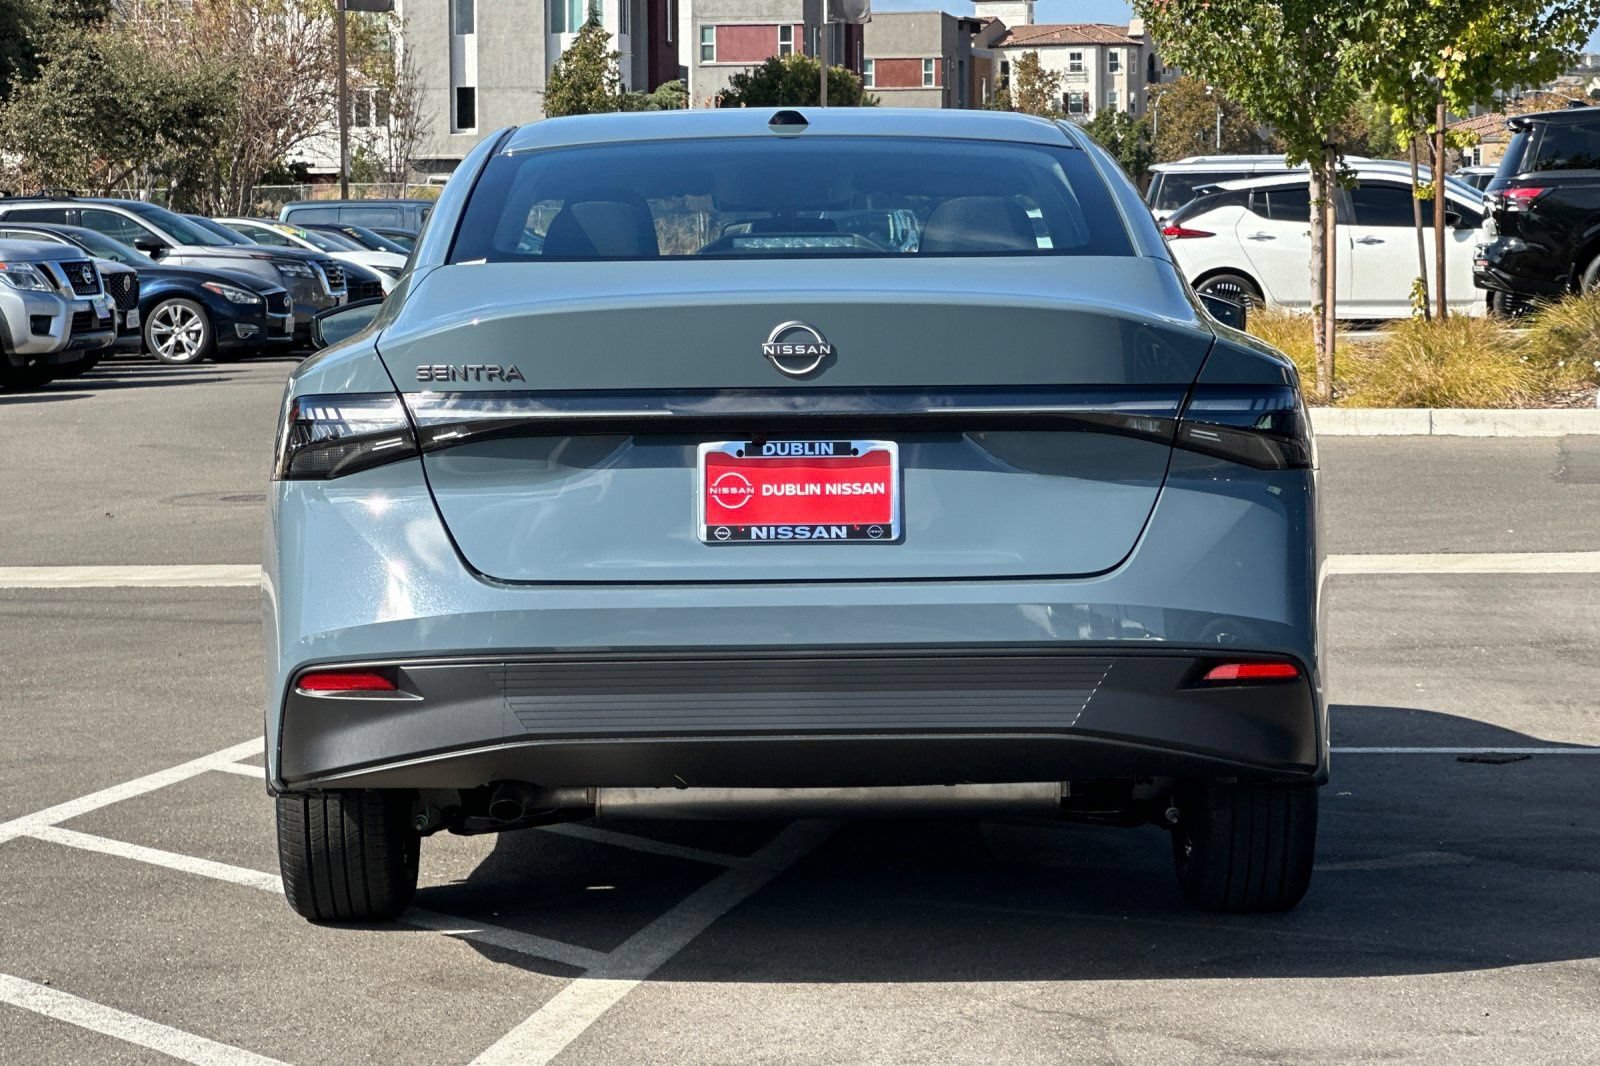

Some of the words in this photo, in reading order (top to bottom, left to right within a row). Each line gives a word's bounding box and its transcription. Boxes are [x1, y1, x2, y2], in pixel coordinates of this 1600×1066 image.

[763, 345, 831, 355] NISSAN
[416, 364, 525, 382] SENTRA
[762, 442, 834, 456] DUBLIN
[709, 486, 755, 494] NISSAN
[761, 483, 821, 496] DUBLIN
[825, 482, 885, 495] NISSAN
[751, 526, 848, 539] NISSAN
